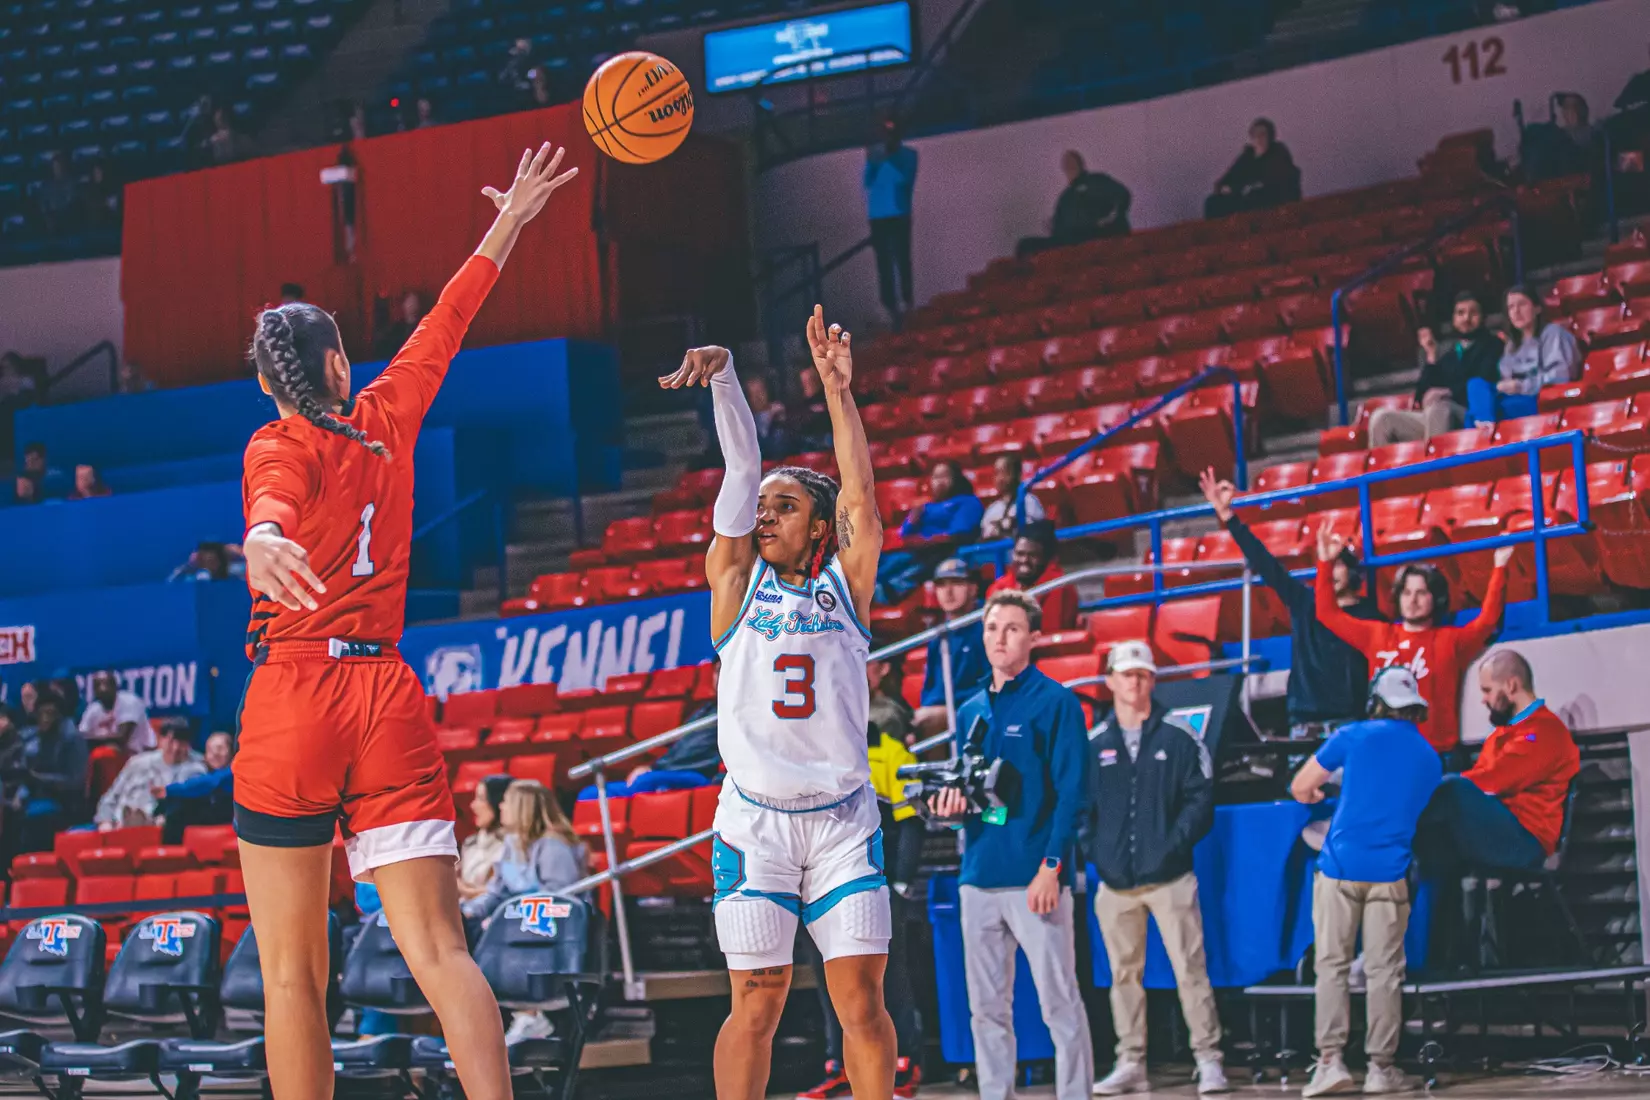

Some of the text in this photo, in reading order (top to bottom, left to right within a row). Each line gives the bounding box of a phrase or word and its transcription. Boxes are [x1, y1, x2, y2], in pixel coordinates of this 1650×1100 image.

[1442, 37, 1507, 84] 112
[352, 502, 375, 576] 1
[747, 606, 784, 641] Lady
[772, 654, 816, 719] 3
